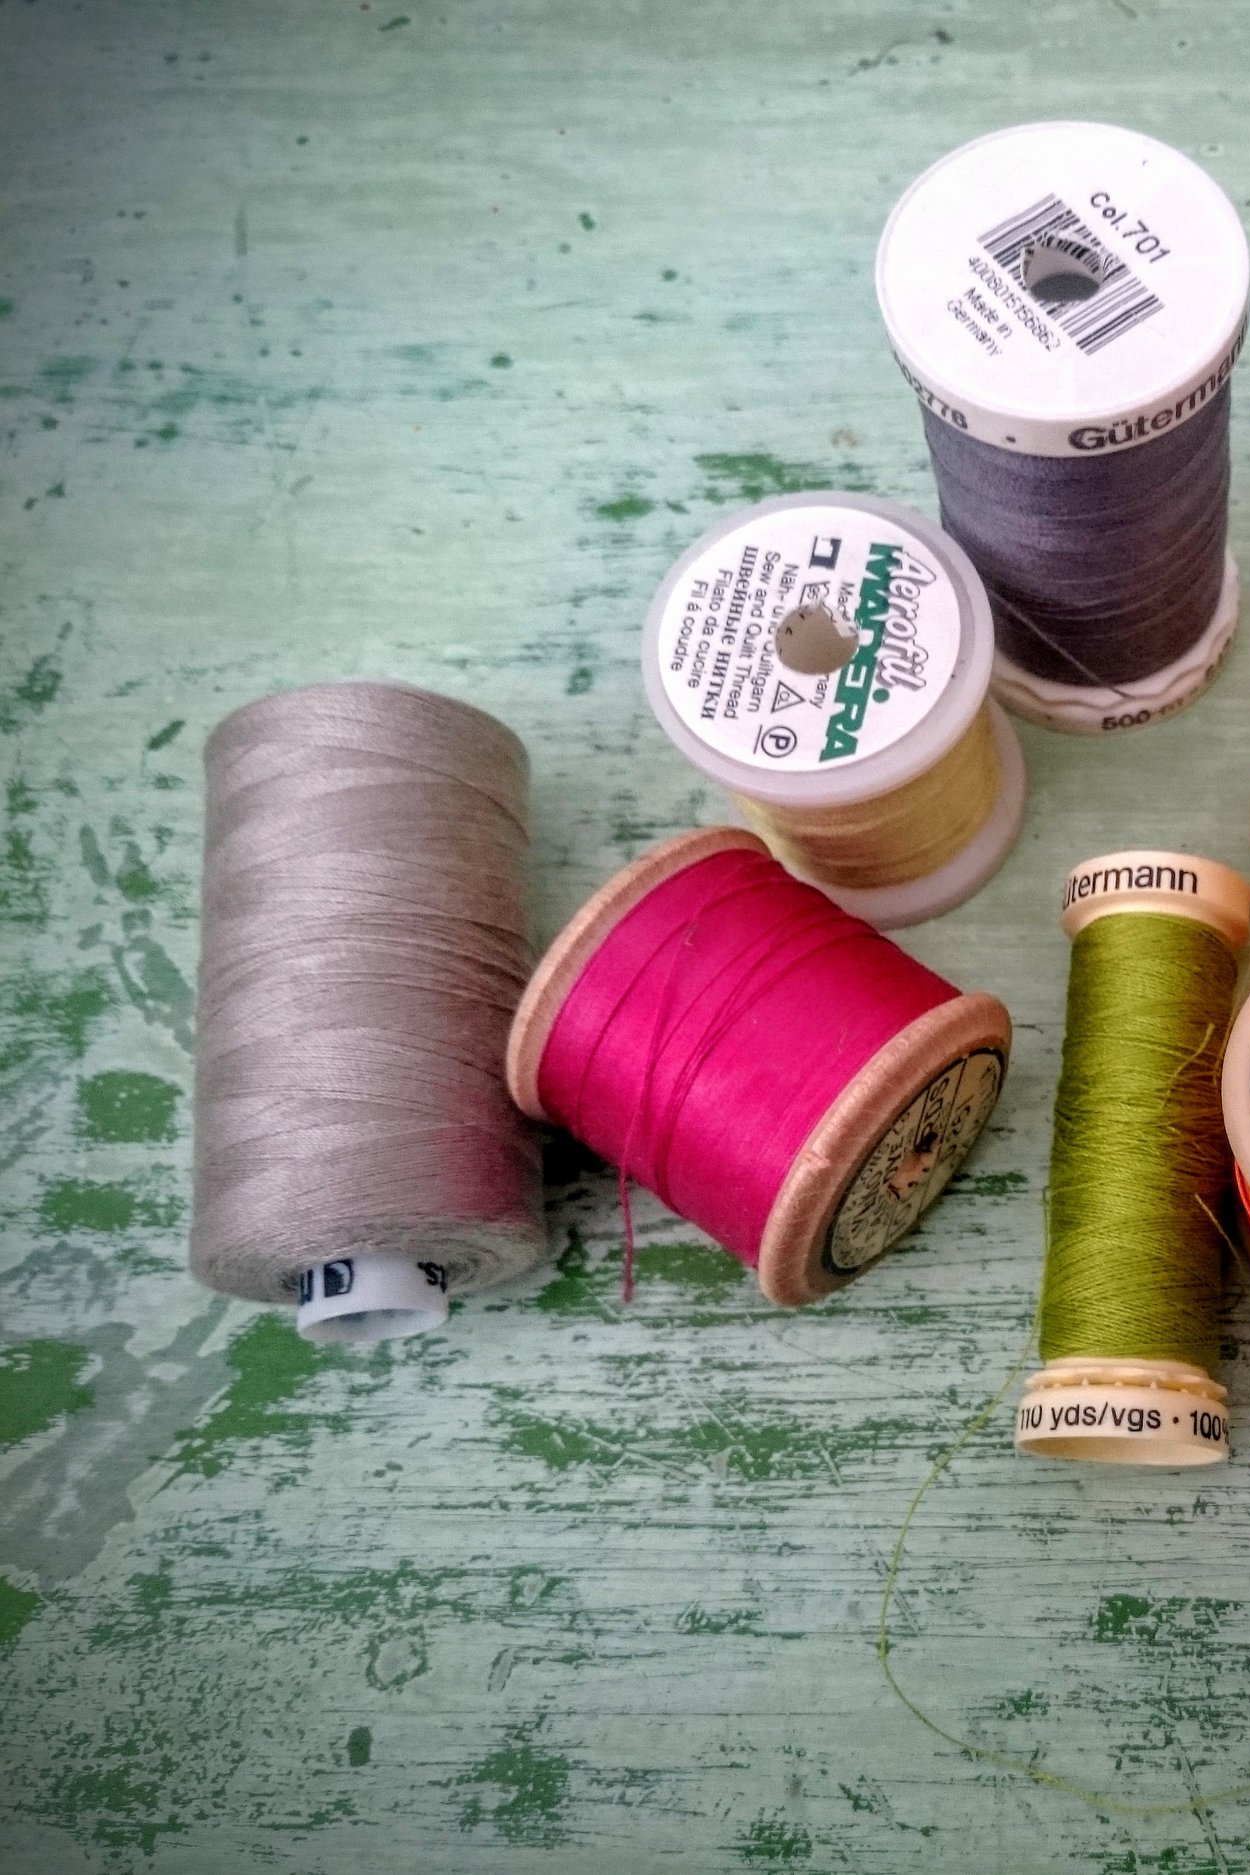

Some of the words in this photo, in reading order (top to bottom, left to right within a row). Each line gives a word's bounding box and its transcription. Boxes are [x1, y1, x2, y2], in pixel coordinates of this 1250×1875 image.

[963, 287, 999, 323] Made
[947, 299, 1002, 356] Germany
[760, 551, 781, 585] Sew
[691, 579, 709, 599] Fil
[710, 568, 733, 612] Filato
[751, 589, 767, 618] and
[702, 615, 719, 636] da
[739, 624, 762, 659] Quilt
[671, 617, 695, 672] coudre
[688, 640, 710, 688] cucire
[701, 651, 731, 720] нитки
[724, 665, 752, 720] Thread
[1101, 710, 1151, 731] 500
[1020, 1404, 1043, 1430] 110
[1049, 1401, 1162, 1432] yds/vgs
